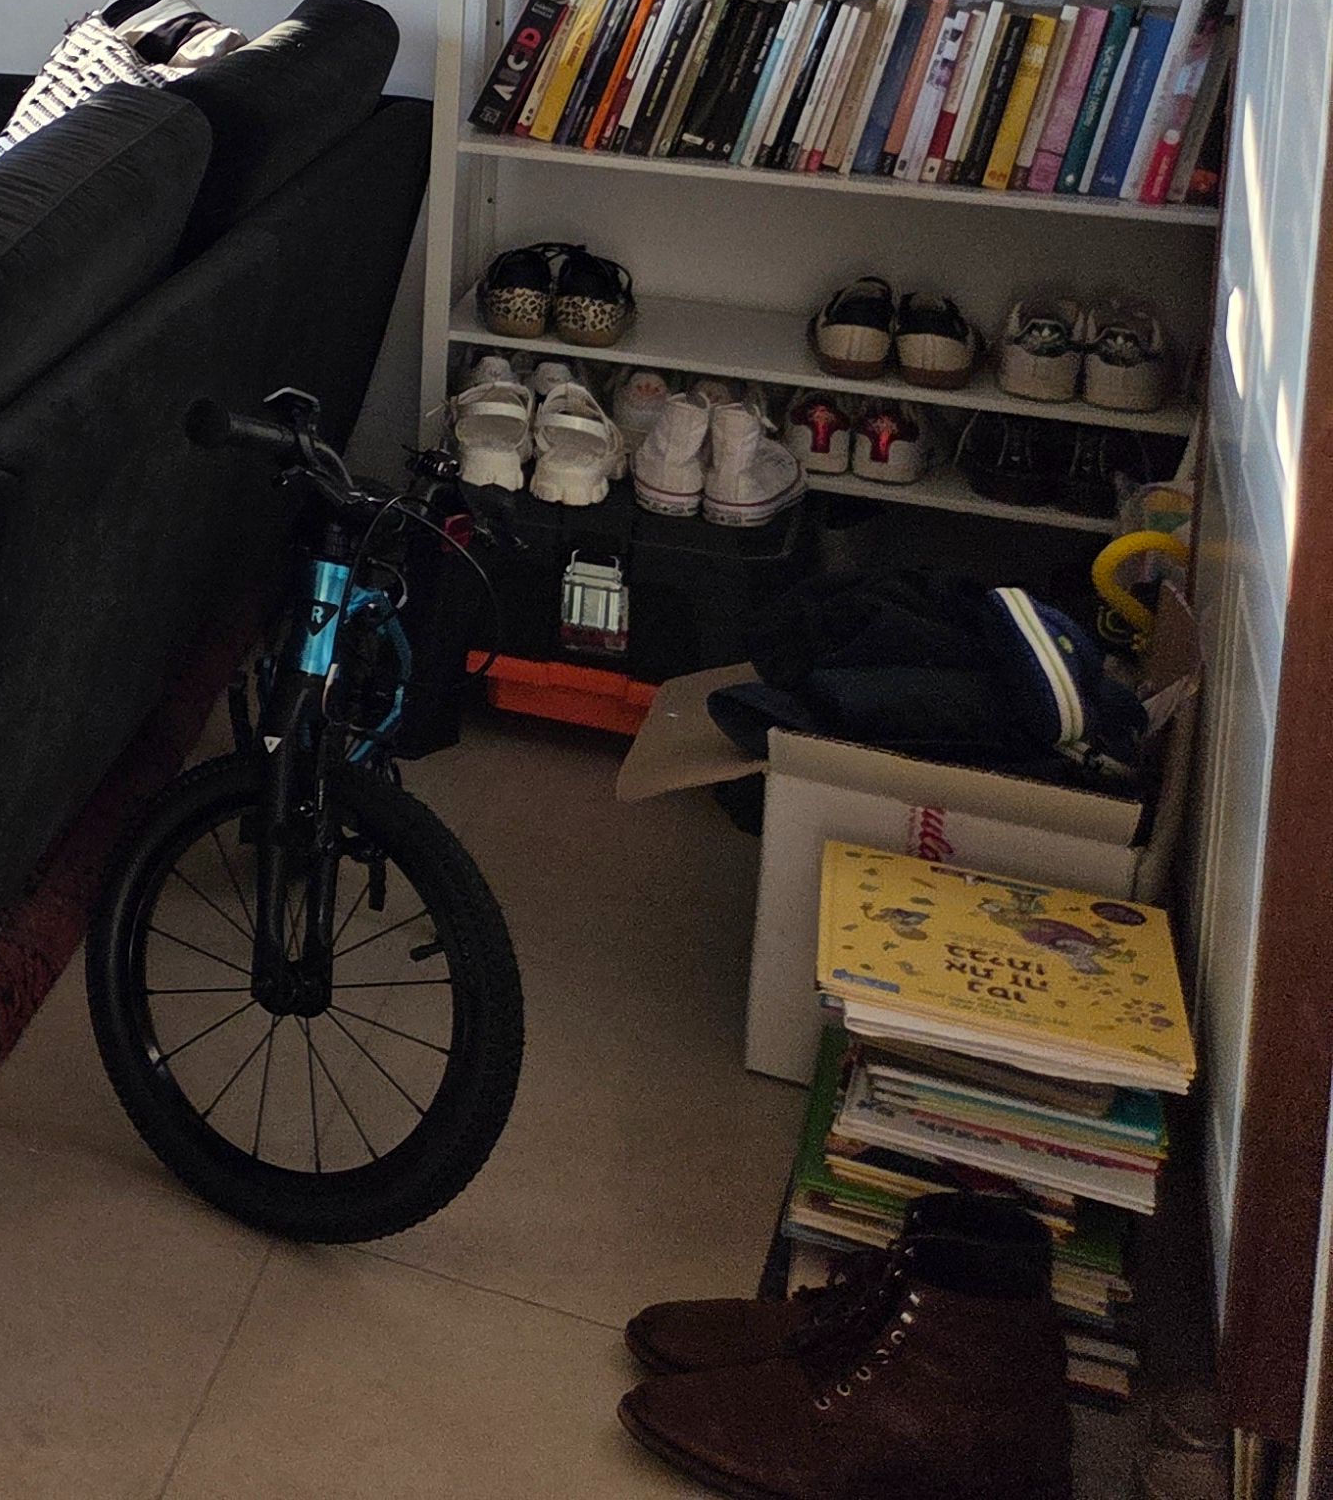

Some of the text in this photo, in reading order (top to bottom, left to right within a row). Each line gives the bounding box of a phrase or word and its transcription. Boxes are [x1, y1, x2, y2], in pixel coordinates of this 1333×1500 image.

[311, 605, 324, 624] R
[944, 959, 1049, 992] את זה
[967, 979, 1027, 1004] נסו
